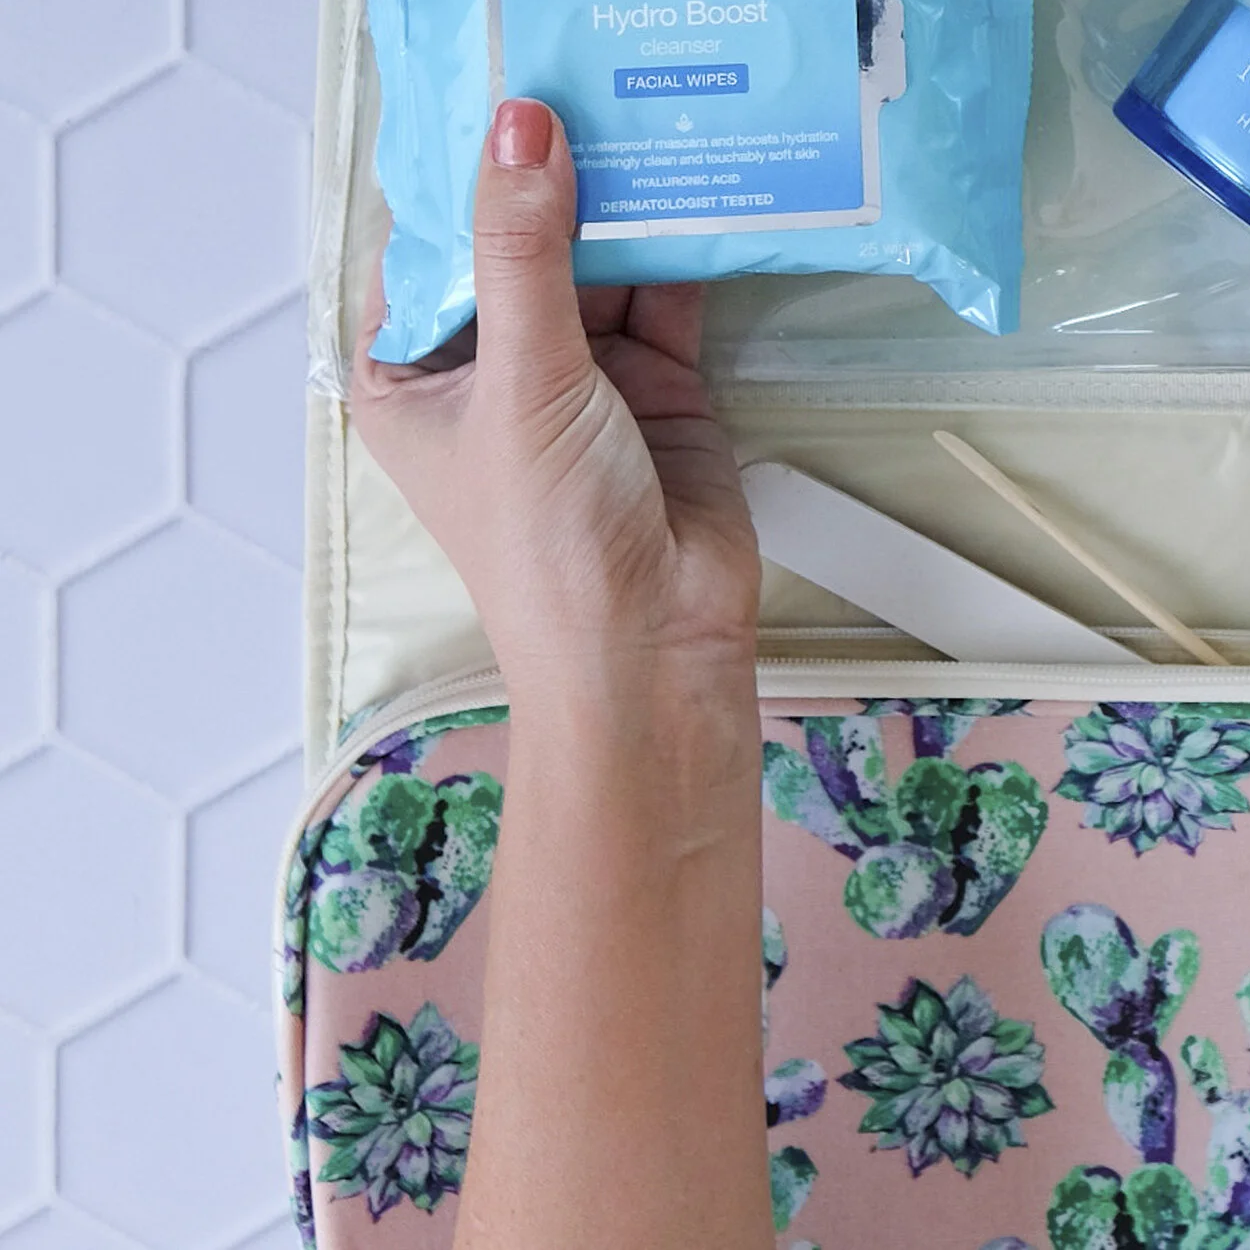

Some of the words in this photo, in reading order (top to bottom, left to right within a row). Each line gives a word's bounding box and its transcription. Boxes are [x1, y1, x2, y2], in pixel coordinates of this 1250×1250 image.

[592, 3, 677, 35] Hydro
[686, 0, 768, 26] Boost
[640, 38, 721, 56] cleanser
[626, 74, 681, 90] FACIAL
[686, 72, 738, 87] WIPES
[588, 138, 651, 155] waterproof
[655, 137, 708, 150] mascara
[711, 135, 734, 148] and
[737, 134, 779, 147] boosts
[782, 131, 838, 147] hydration
[644, 153, 677, 167] clean
[680, 152, 704, 165] and
[706, 149, 765, 165] touchably
[769, 149, 792, 162] soft
[795, 148, 819, 161] skin
[632, 174, 709, 189] HYALURONIC
[711, 173, 740, 186] ACID
[600, 196, 717, 214] DERMATOLOGIST
[720, 193, 774, 208] TESTED
